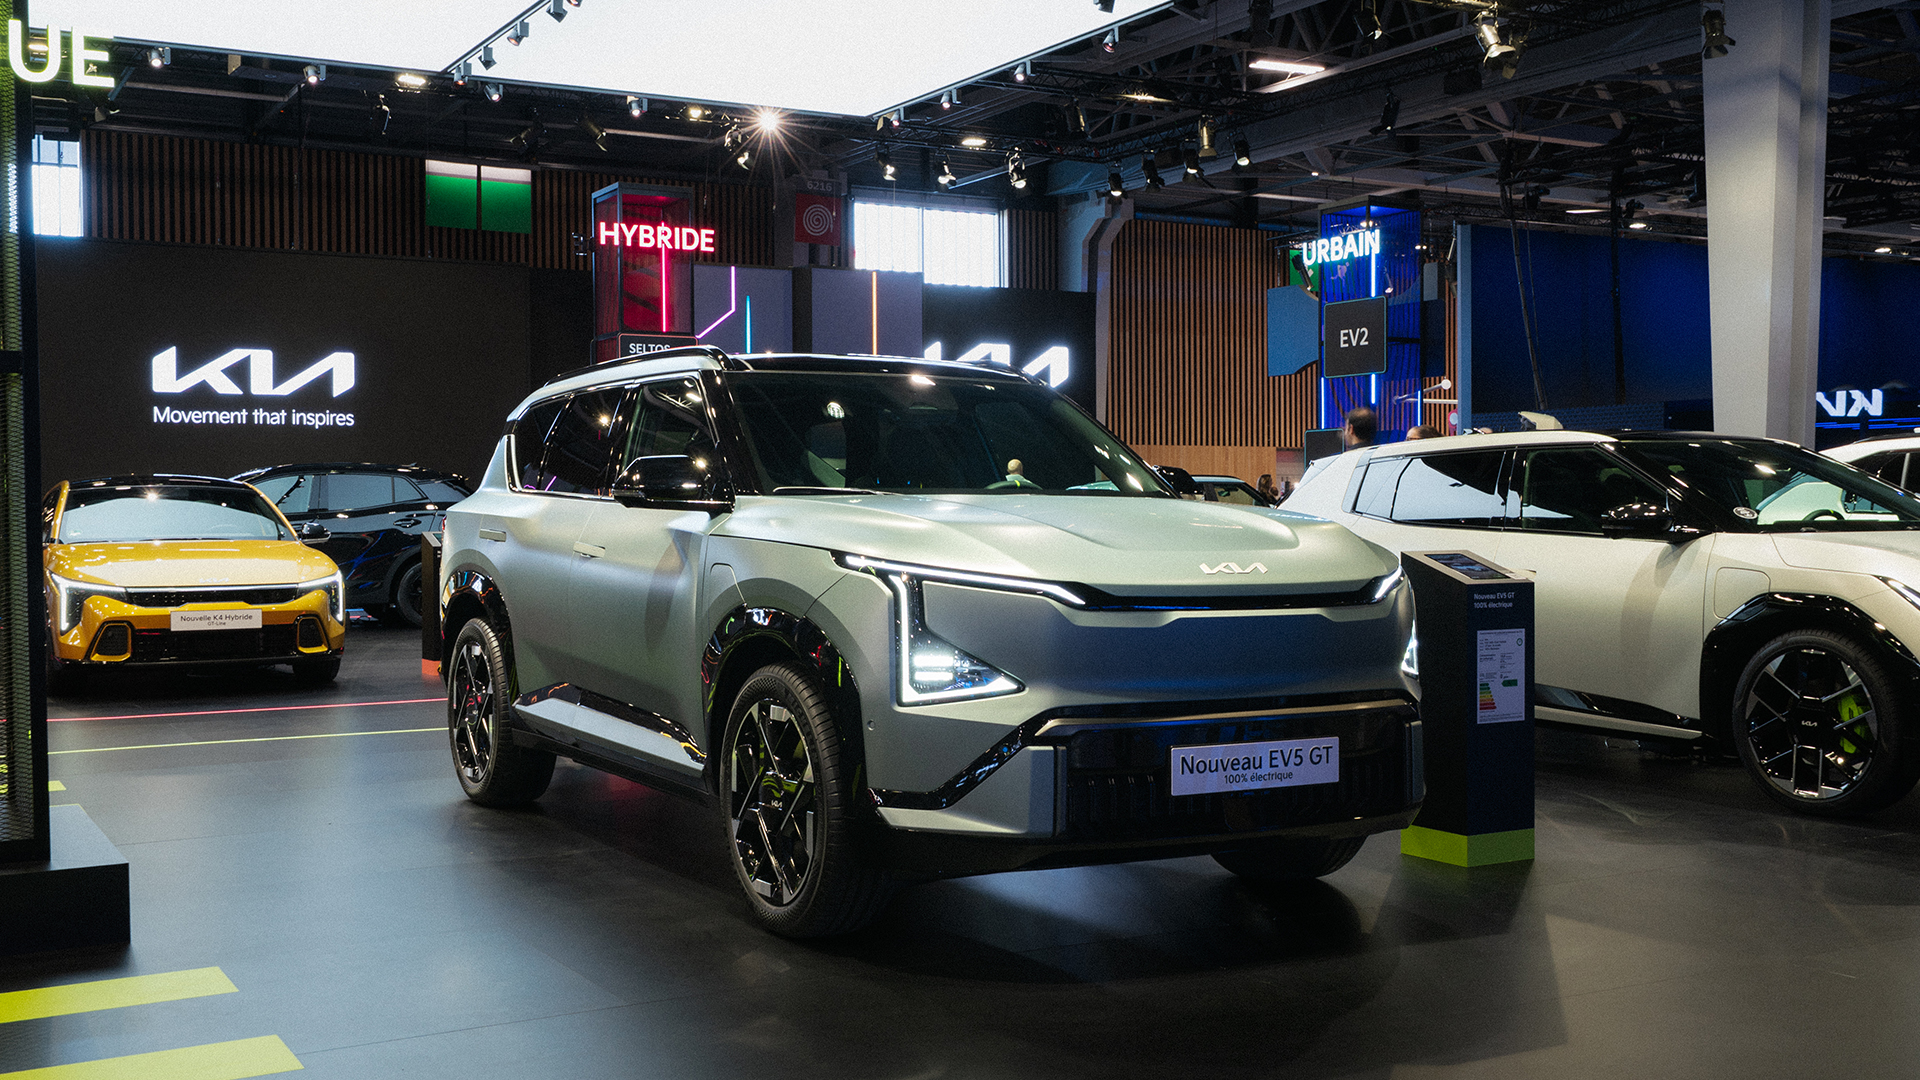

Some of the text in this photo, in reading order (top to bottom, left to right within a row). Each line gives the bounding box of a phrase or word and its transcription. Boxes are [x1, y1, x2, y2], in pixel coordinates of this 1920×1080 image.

[807, 181, 833, 191] 6216
[600, 221, 715, 252] HYBRIDE
[1302, 229, 1380, 266] URBAIN
[1340, 327, 1369, 348] EV2
[152, 346, 355, 398] KIA
[153, 406, 355, 429] Movement that inspires
[1199, 562, 1268, 575] KIA
[180, 614, 211, 622] Nouvelle
[224, 613, 253, 622] Hybride
[1180, 745, 1333, 775] Nouveau EV5 GT
[1224, 771, 1293, 784] 100% électrique
